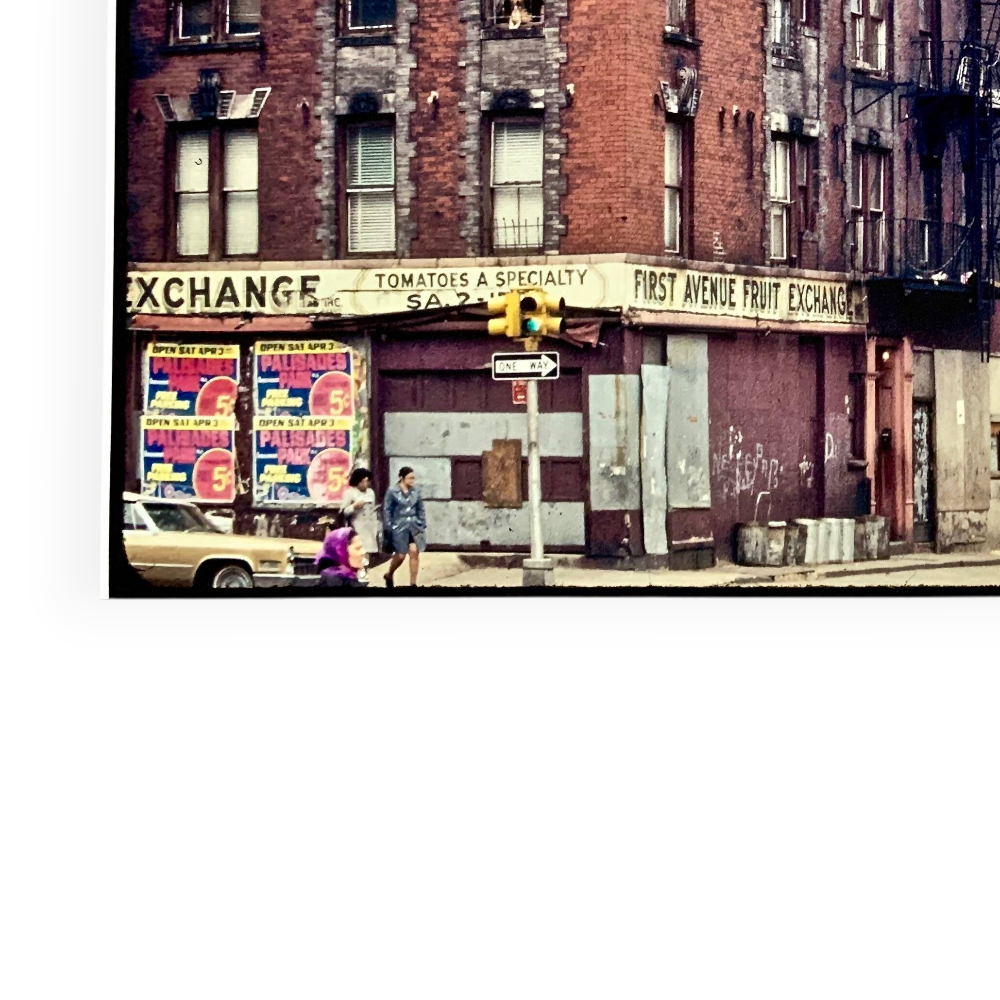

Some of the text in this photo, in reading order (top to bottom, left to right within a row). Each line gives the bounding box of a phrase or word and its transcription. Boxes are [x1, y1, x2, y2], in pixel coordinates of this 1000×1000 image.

[375, 269, 588, 288] TOMATOES A SPECIALTY
[634, 269, 677, 301] FIRST
[684, 274, 737, 307] AVENUE
[743, 279, 781, 312] FRUIT
[152, 346, 176, 354] OPEN
[198, 347, 216, 355] APR
[260, 343, 334, 351] OPEN SAT APR 3
[152, 356, 234, 375] PALISADES
[261, 353, 347, 372] PALISADES
[498, 360, 549, 371] ONE WAY
[146, 418, 219, 427] OPEN SAT APR 3
[259, 418, 335, 426] OPEN SAT APR 3
[147, 429, 230, 447] PALISADES
[260, 430, 346, 448] PALISADES
